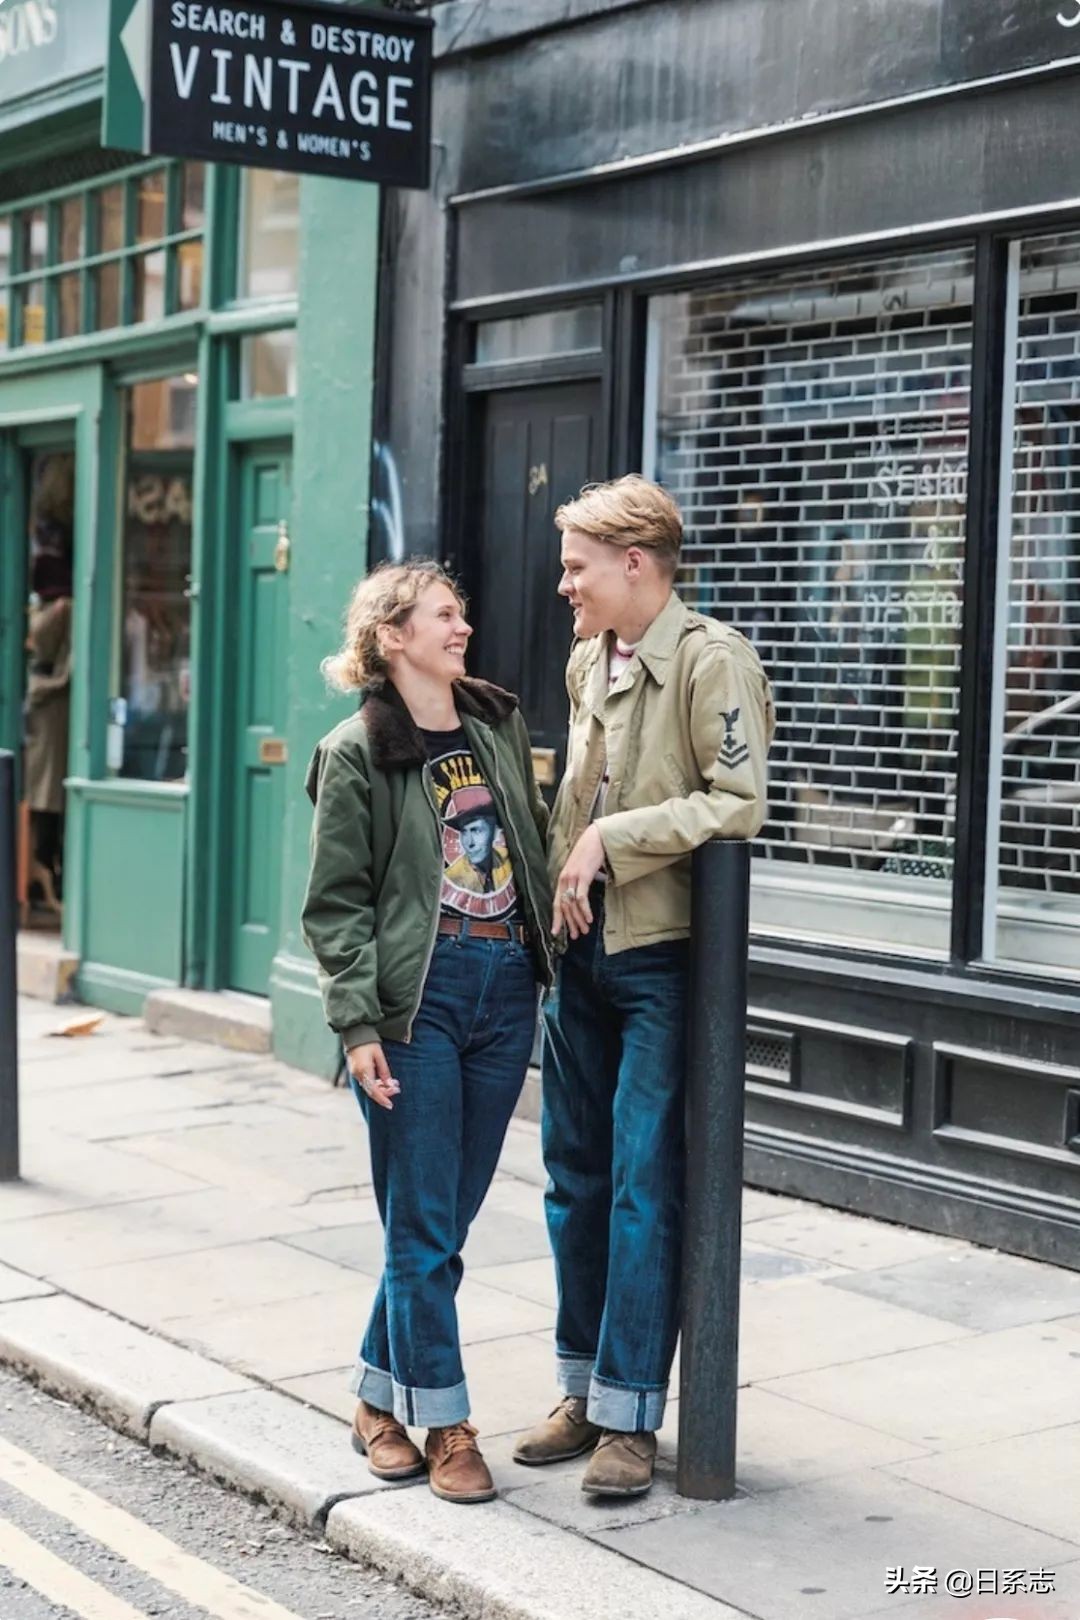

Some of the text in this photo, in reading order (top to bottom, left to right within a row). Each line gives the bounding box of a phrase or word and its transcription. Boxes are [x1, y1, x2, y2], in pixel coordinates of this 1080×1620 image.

[170, 0, 415, 64] SEARCH & DESTROY
[169, 41, 414, 131] VINTAGE
[212, 120, 371, 162] MEN'S & WOMEN'S
